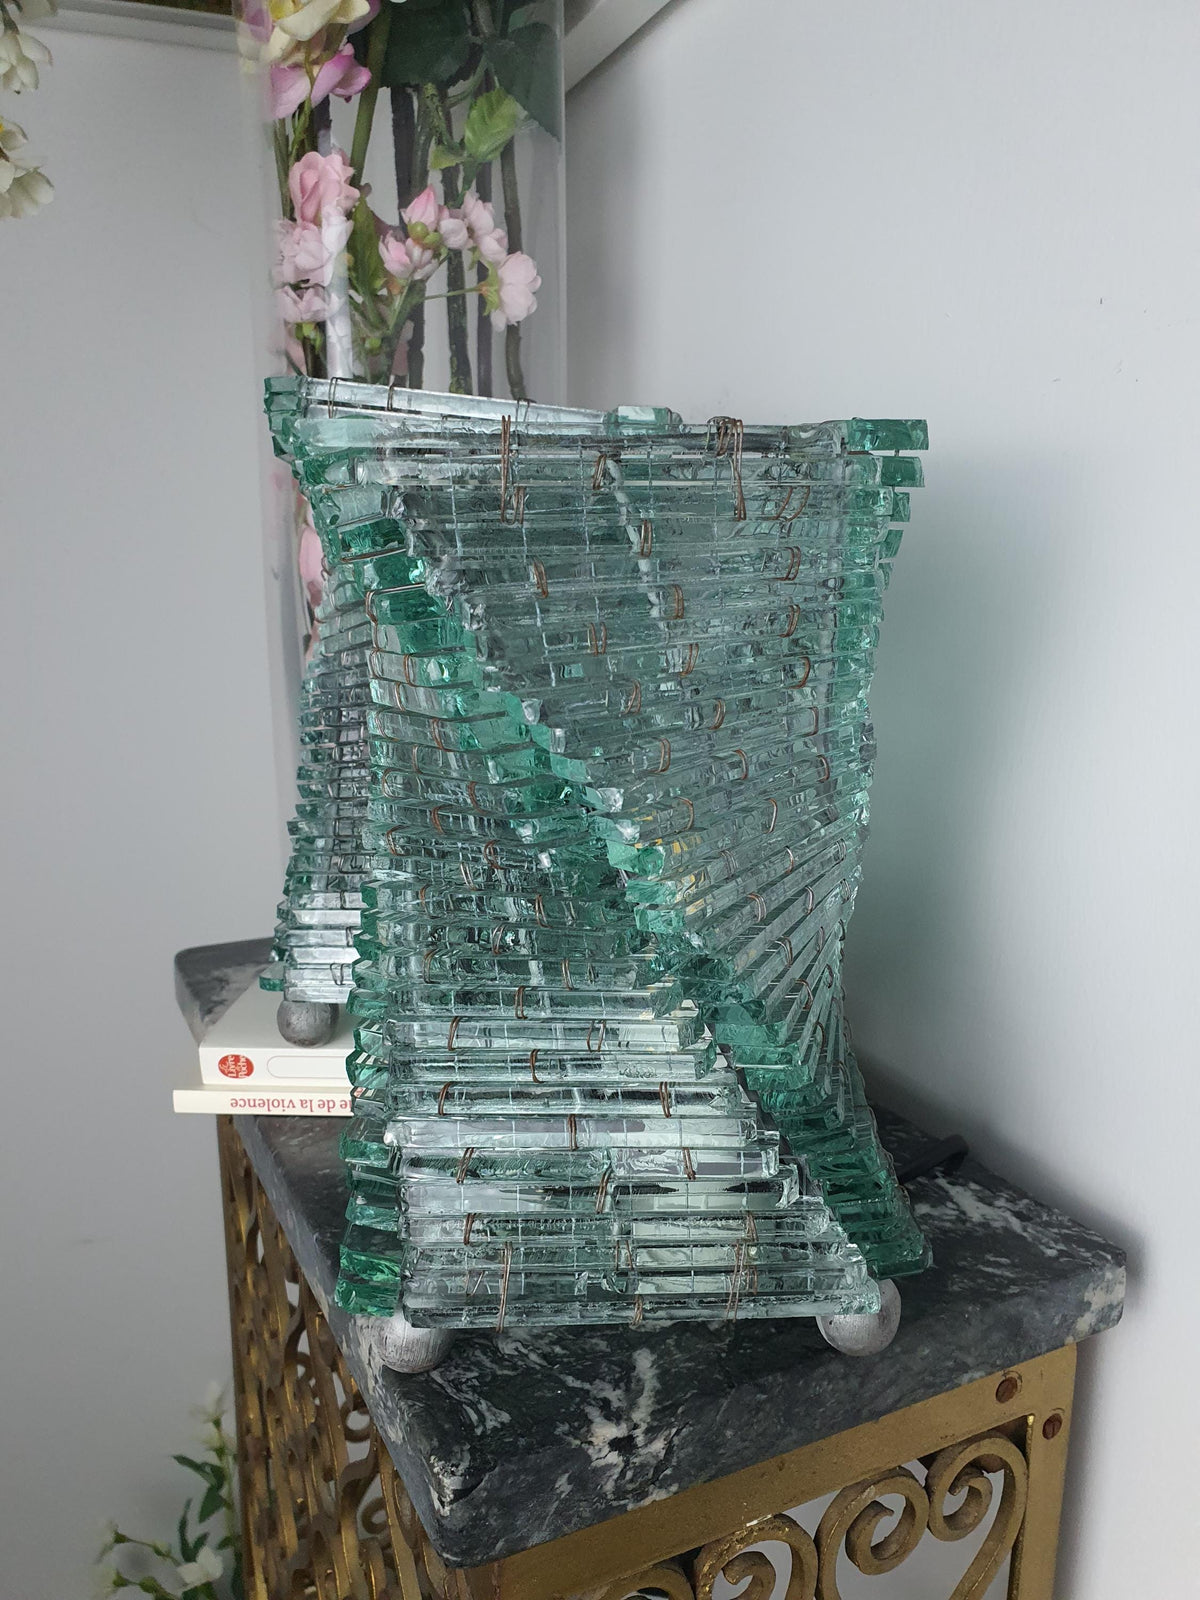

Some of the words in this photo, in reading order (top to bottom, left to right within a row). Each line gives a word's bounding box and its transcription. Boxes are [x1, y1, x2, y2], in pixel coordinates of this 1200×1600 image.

[230, 1098, 296, 1112] violence
[300, 1099, 314, 1113] la
[318, 1099, 336, 1113] de
